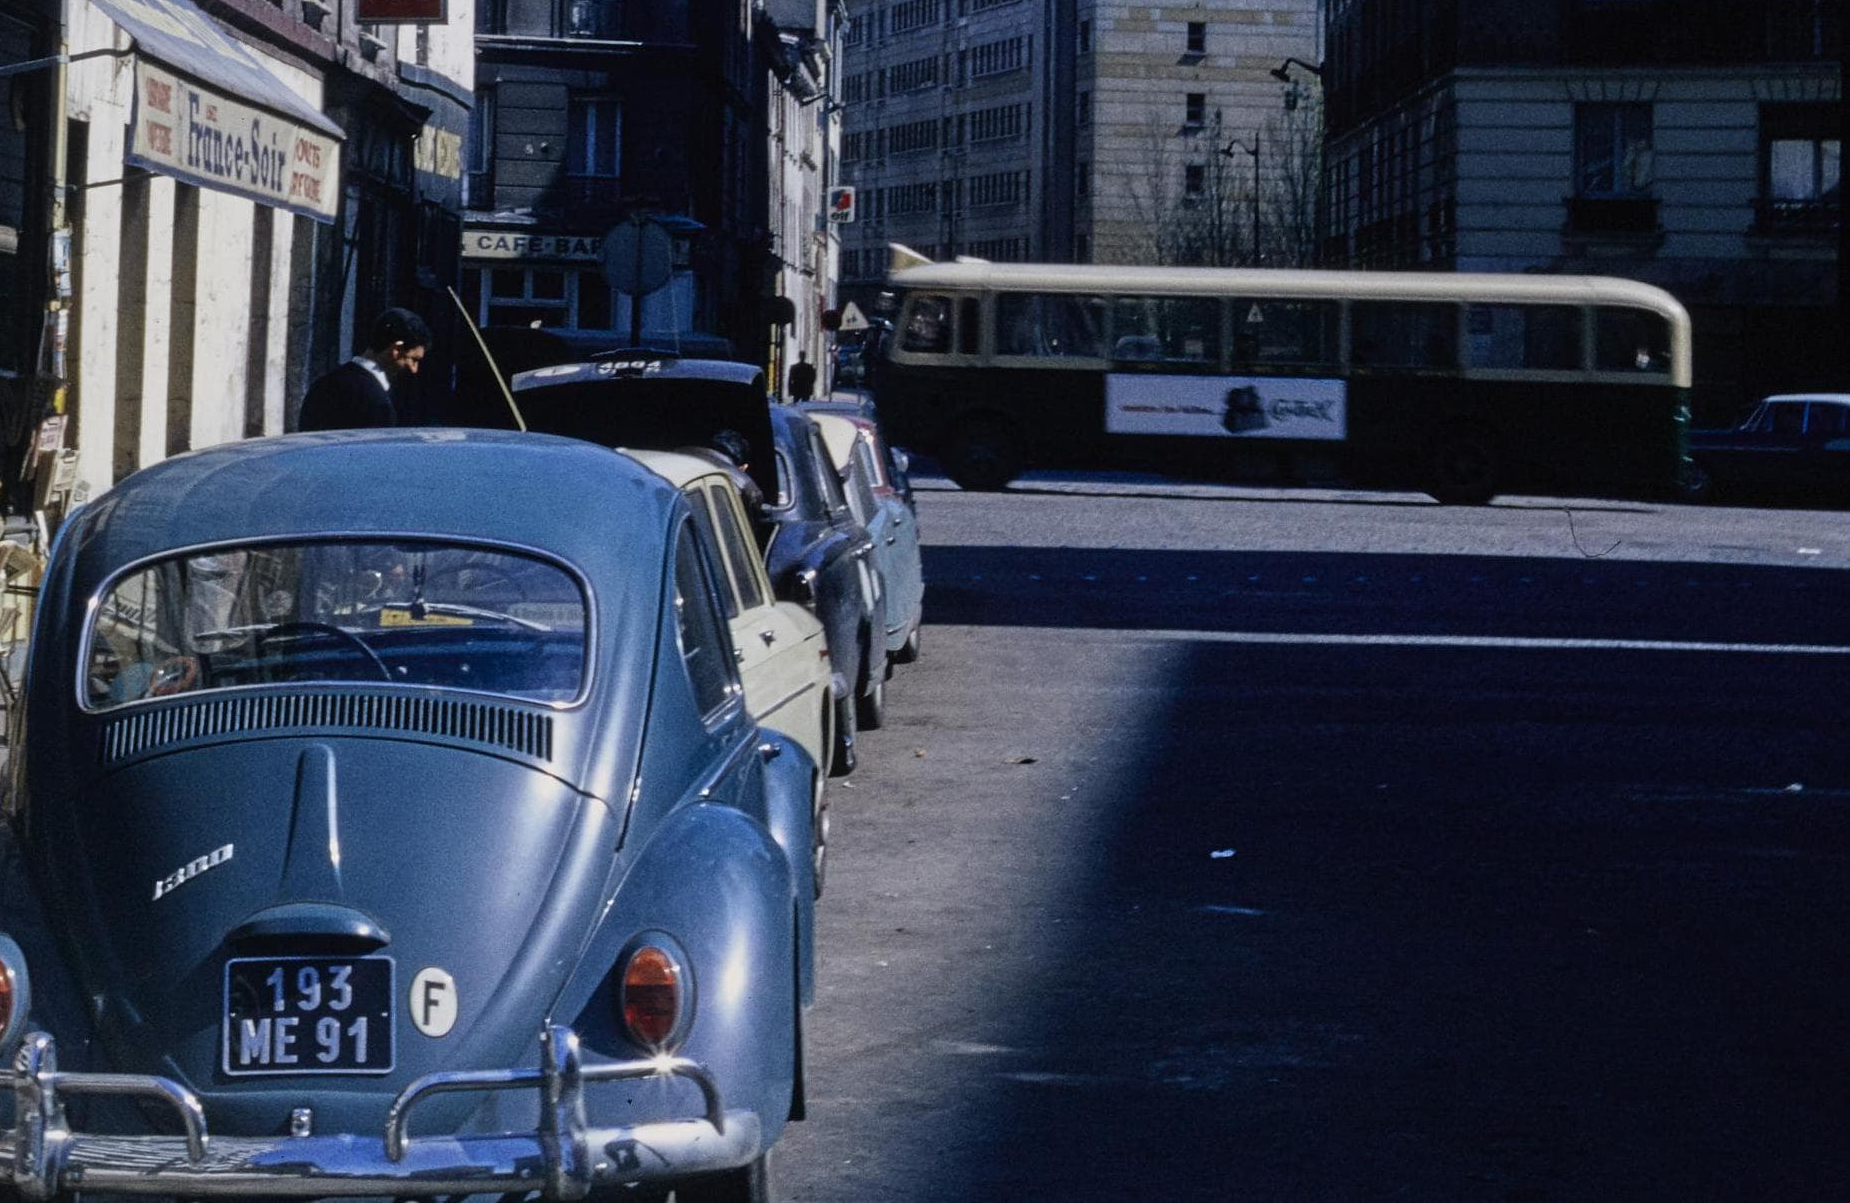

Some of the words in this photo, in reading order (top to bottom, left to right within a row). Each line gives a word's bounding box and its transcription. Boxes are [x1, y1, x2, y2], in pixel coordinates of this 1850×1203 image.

[188, 90, 286, 193] France-Soir
[266, 965, 352, 1013] 193
[424, 980, 447, 1027] F
[239, 1016, 299, 1066] ME
[314, 1016, 367, 1064] 91
